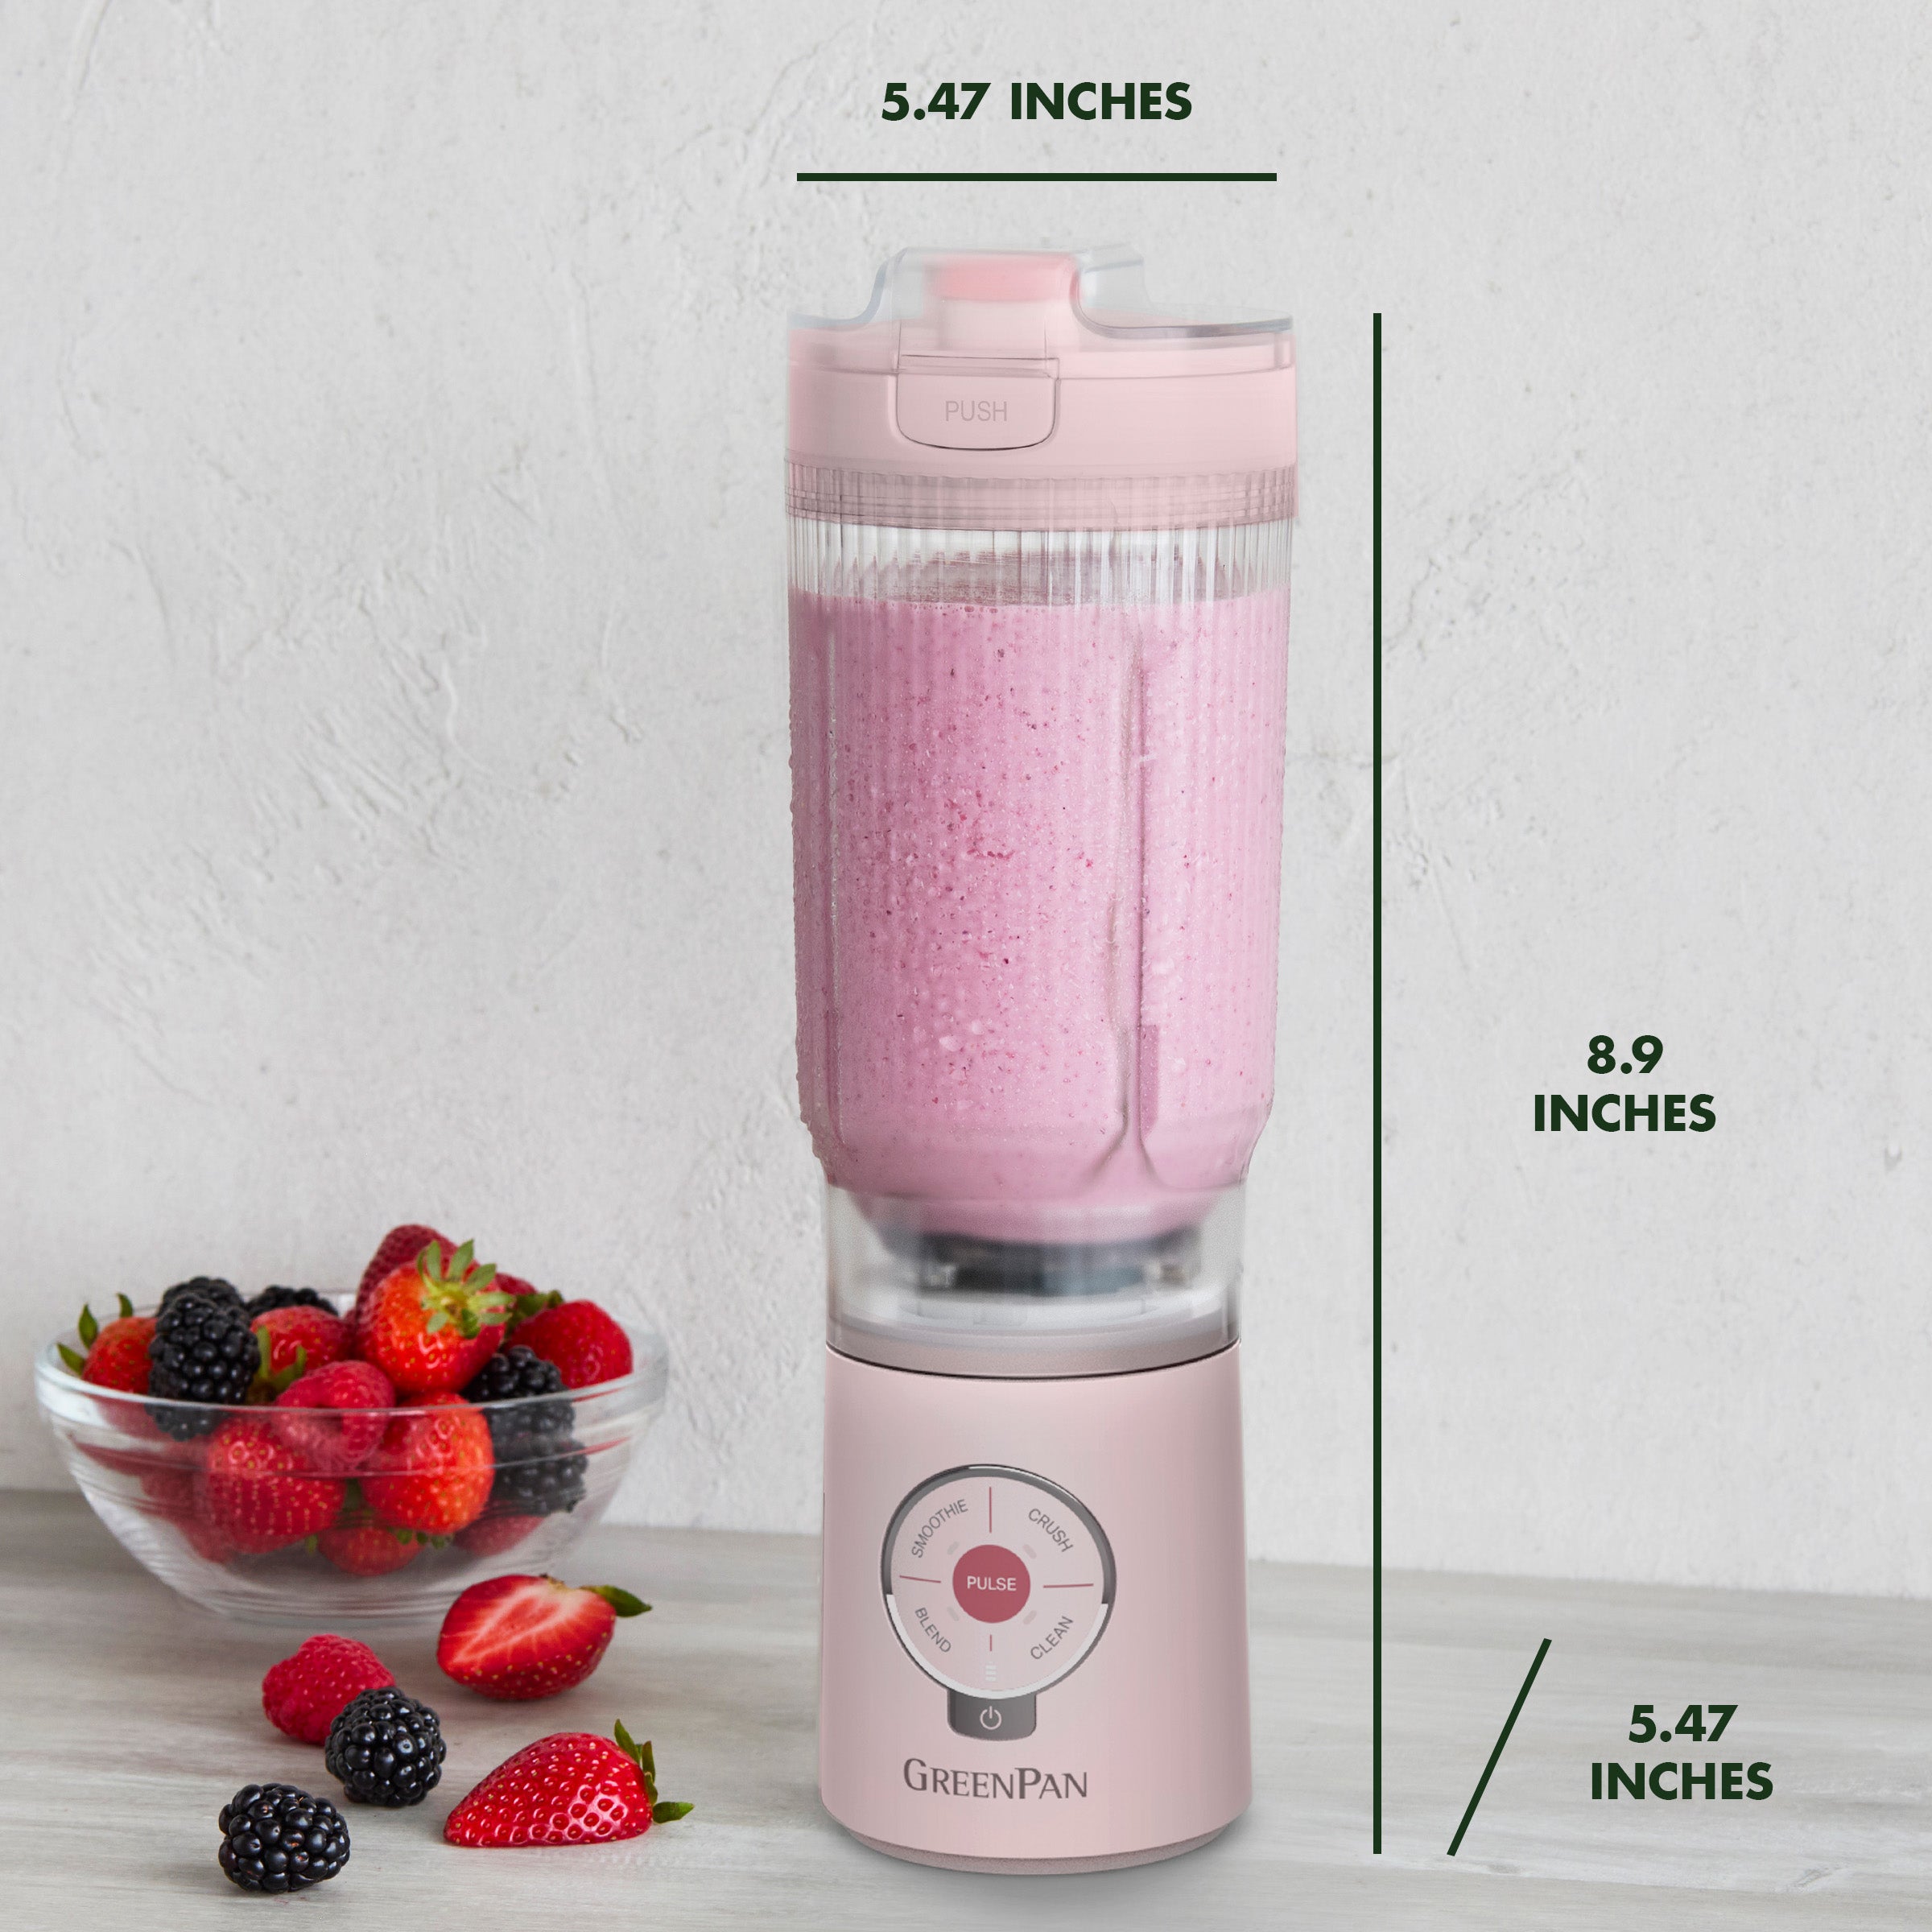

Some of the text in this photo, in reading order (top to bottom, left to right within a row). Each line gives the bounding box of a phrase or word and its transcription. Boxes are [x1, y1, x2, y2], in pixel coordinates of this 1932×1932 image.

[944, 399, 1009, 423] PUSH
[911, 1498, 969, 1559] SMOOTHIE
[1027, 1507, 1075, 1554] CRUSH
[966, 1575, 1018, 1591] PULSE
[914, 1607, 952, 1654] BLEND
[1030, 1615, 1075, 1661] CLEAN
